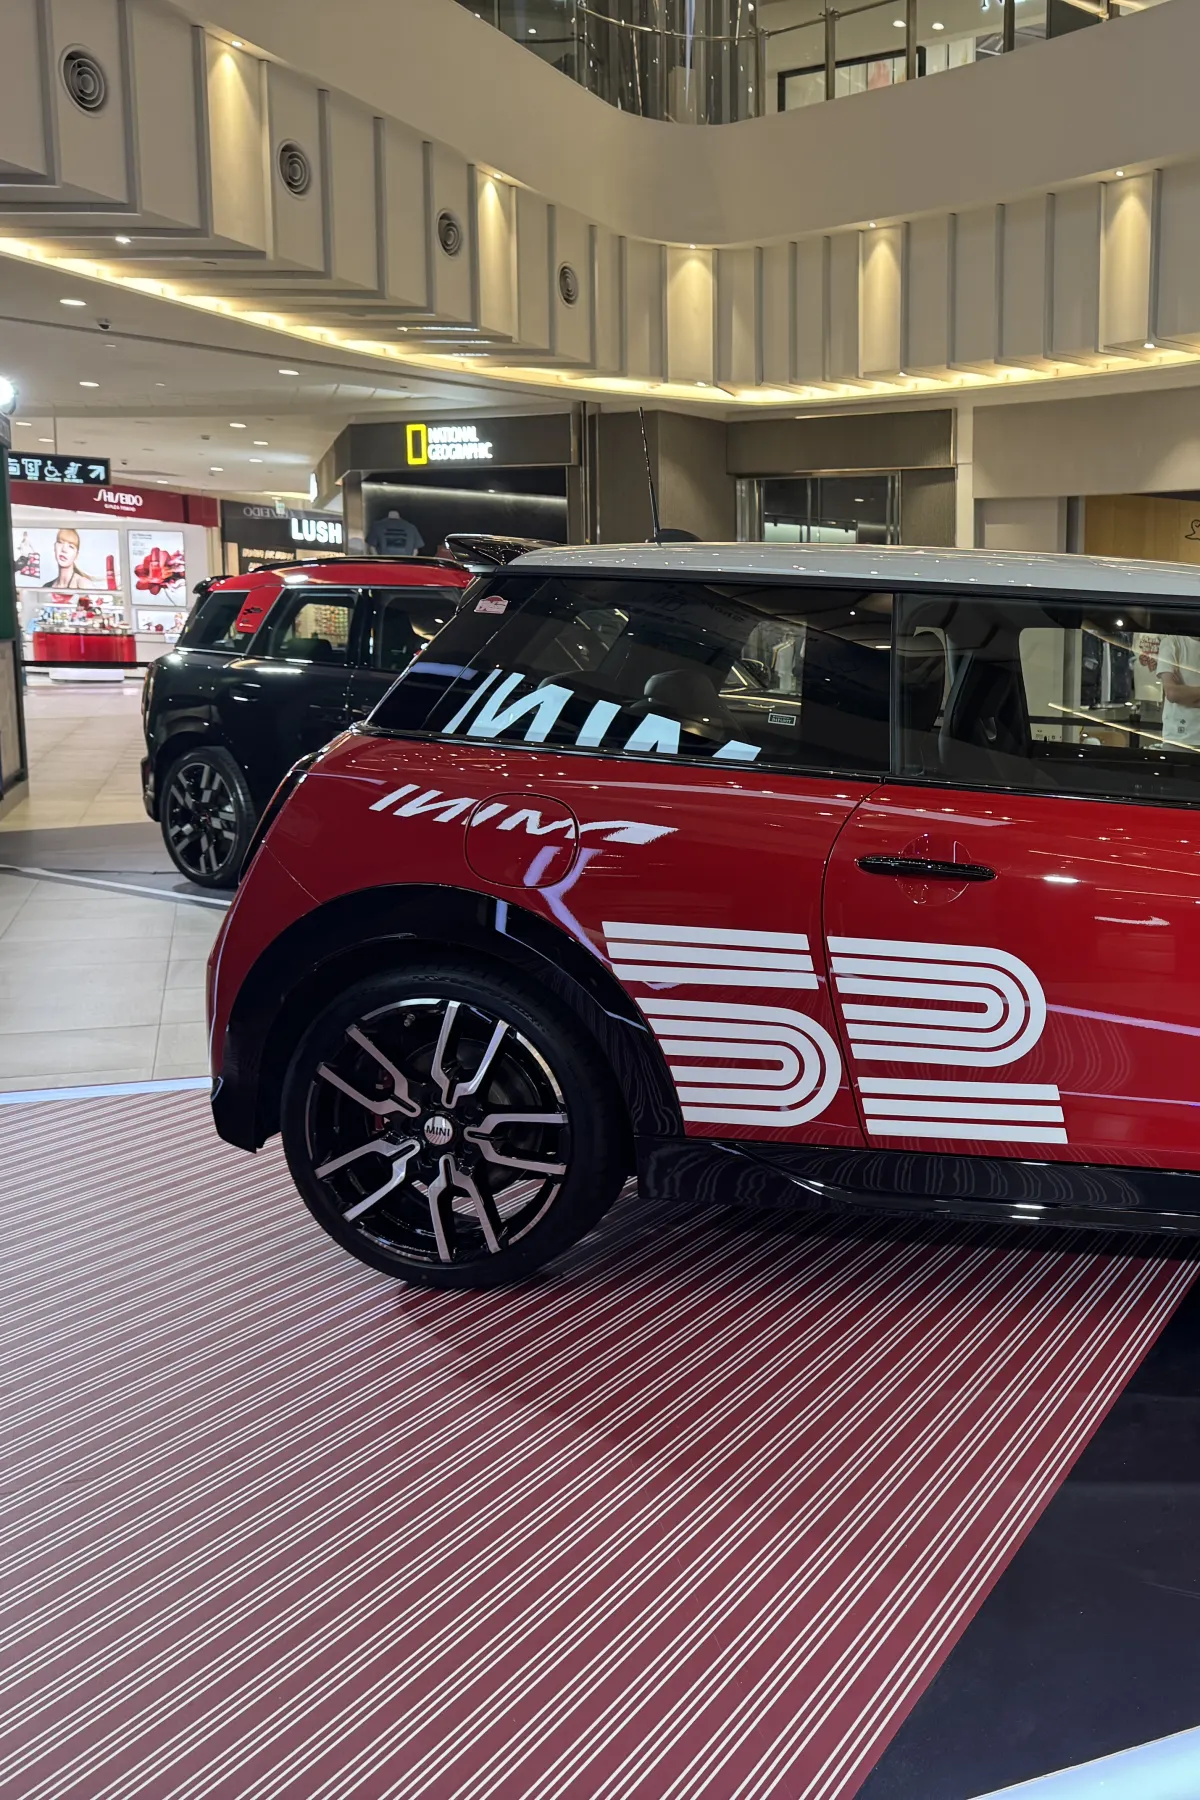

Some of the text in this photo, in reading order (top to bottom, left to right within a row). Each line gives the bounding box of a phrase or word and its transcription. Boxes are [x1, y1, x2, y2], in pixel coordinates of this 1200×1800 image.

[428, 426, 479, 443] NATIONAL
[427, 442, 493, 460] GEOGRAPHIC
[93, 489, 143, 506] SHISEIDO
[291, 518, 342, 544] LUSH
[426, 1125, 450, 1136] MINI
